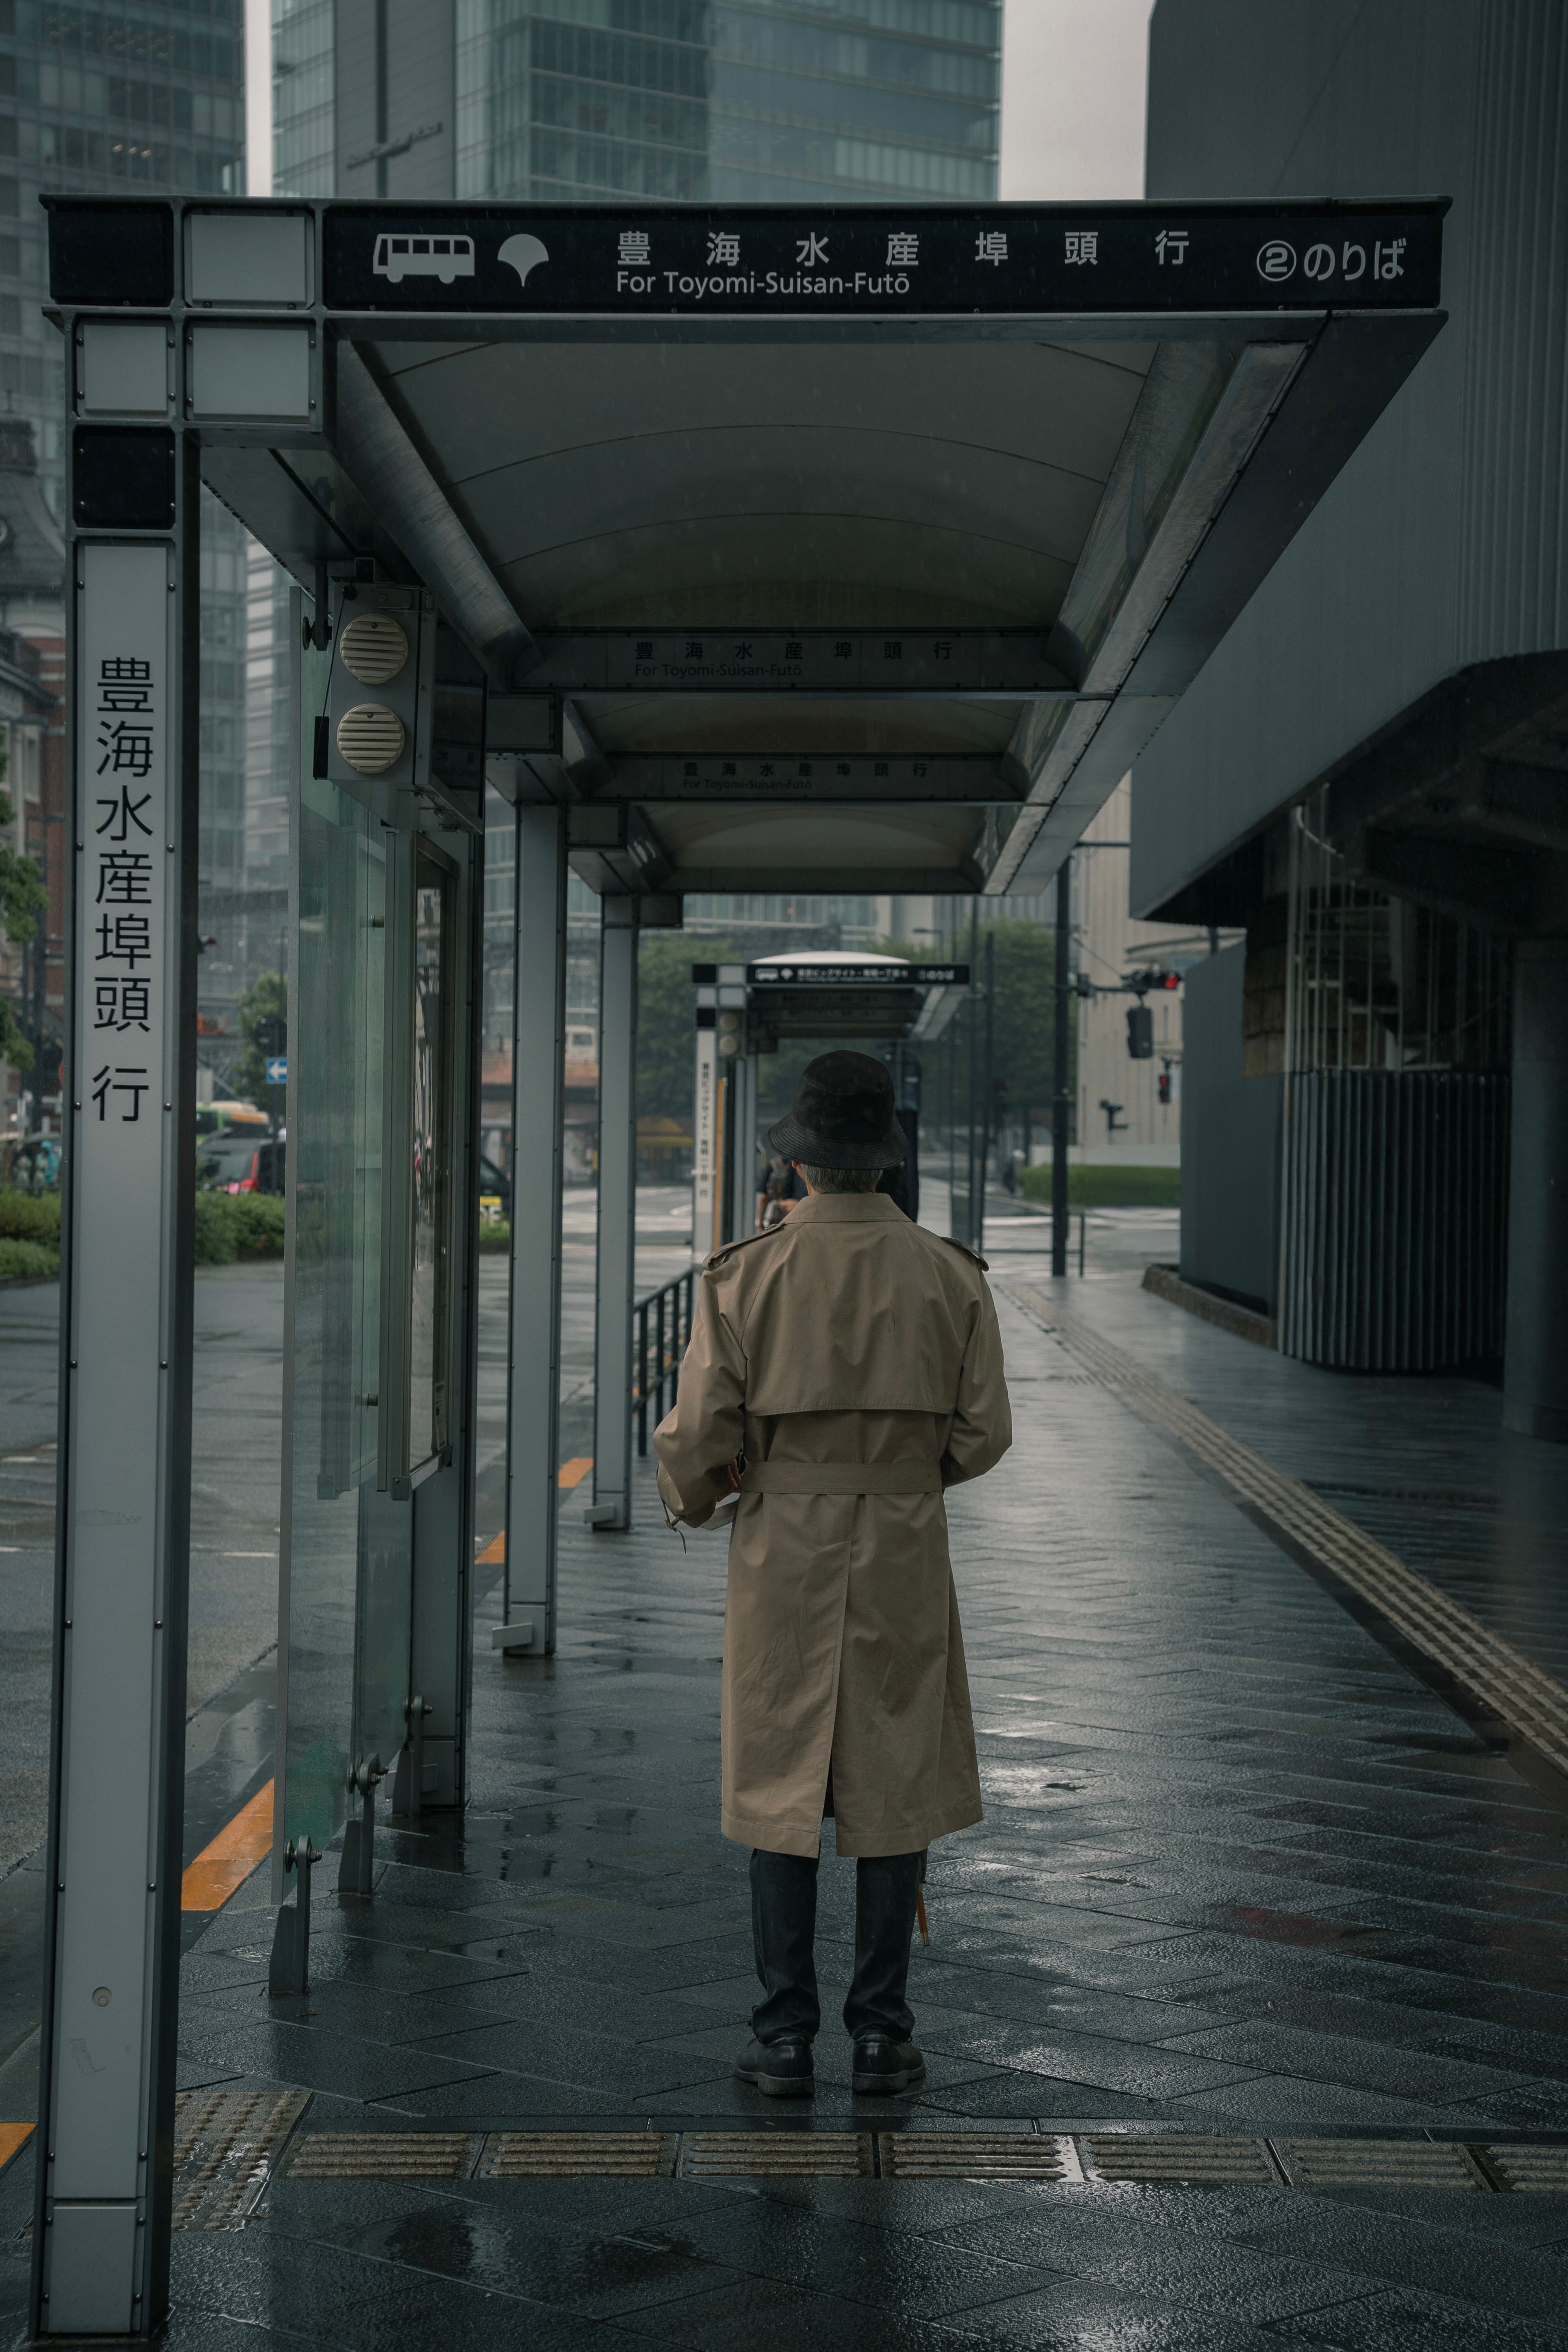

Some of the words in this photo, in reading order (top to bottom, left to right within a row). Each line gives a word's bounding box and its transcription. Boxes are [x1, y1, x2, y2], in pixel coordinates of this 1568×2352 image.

[617, 230, 1189, 266] 豊海水産埠頭行
[617, 271, 656, 294] For
[664, 271, 909, 299] Toyomi-Suisan-Futō
[635, 641, 953, 660] 豊海水産埠頭行
[635, 664, 659, 676] For
[663, 663, 802, 679] Toyomi-Suisan-Futō
[683, 780, 701, 789] For
[704, 780, 812, 791] Toyomi-Suisan-Futō
[91, 656, 154, 1122] 豊海水産埠頭行
